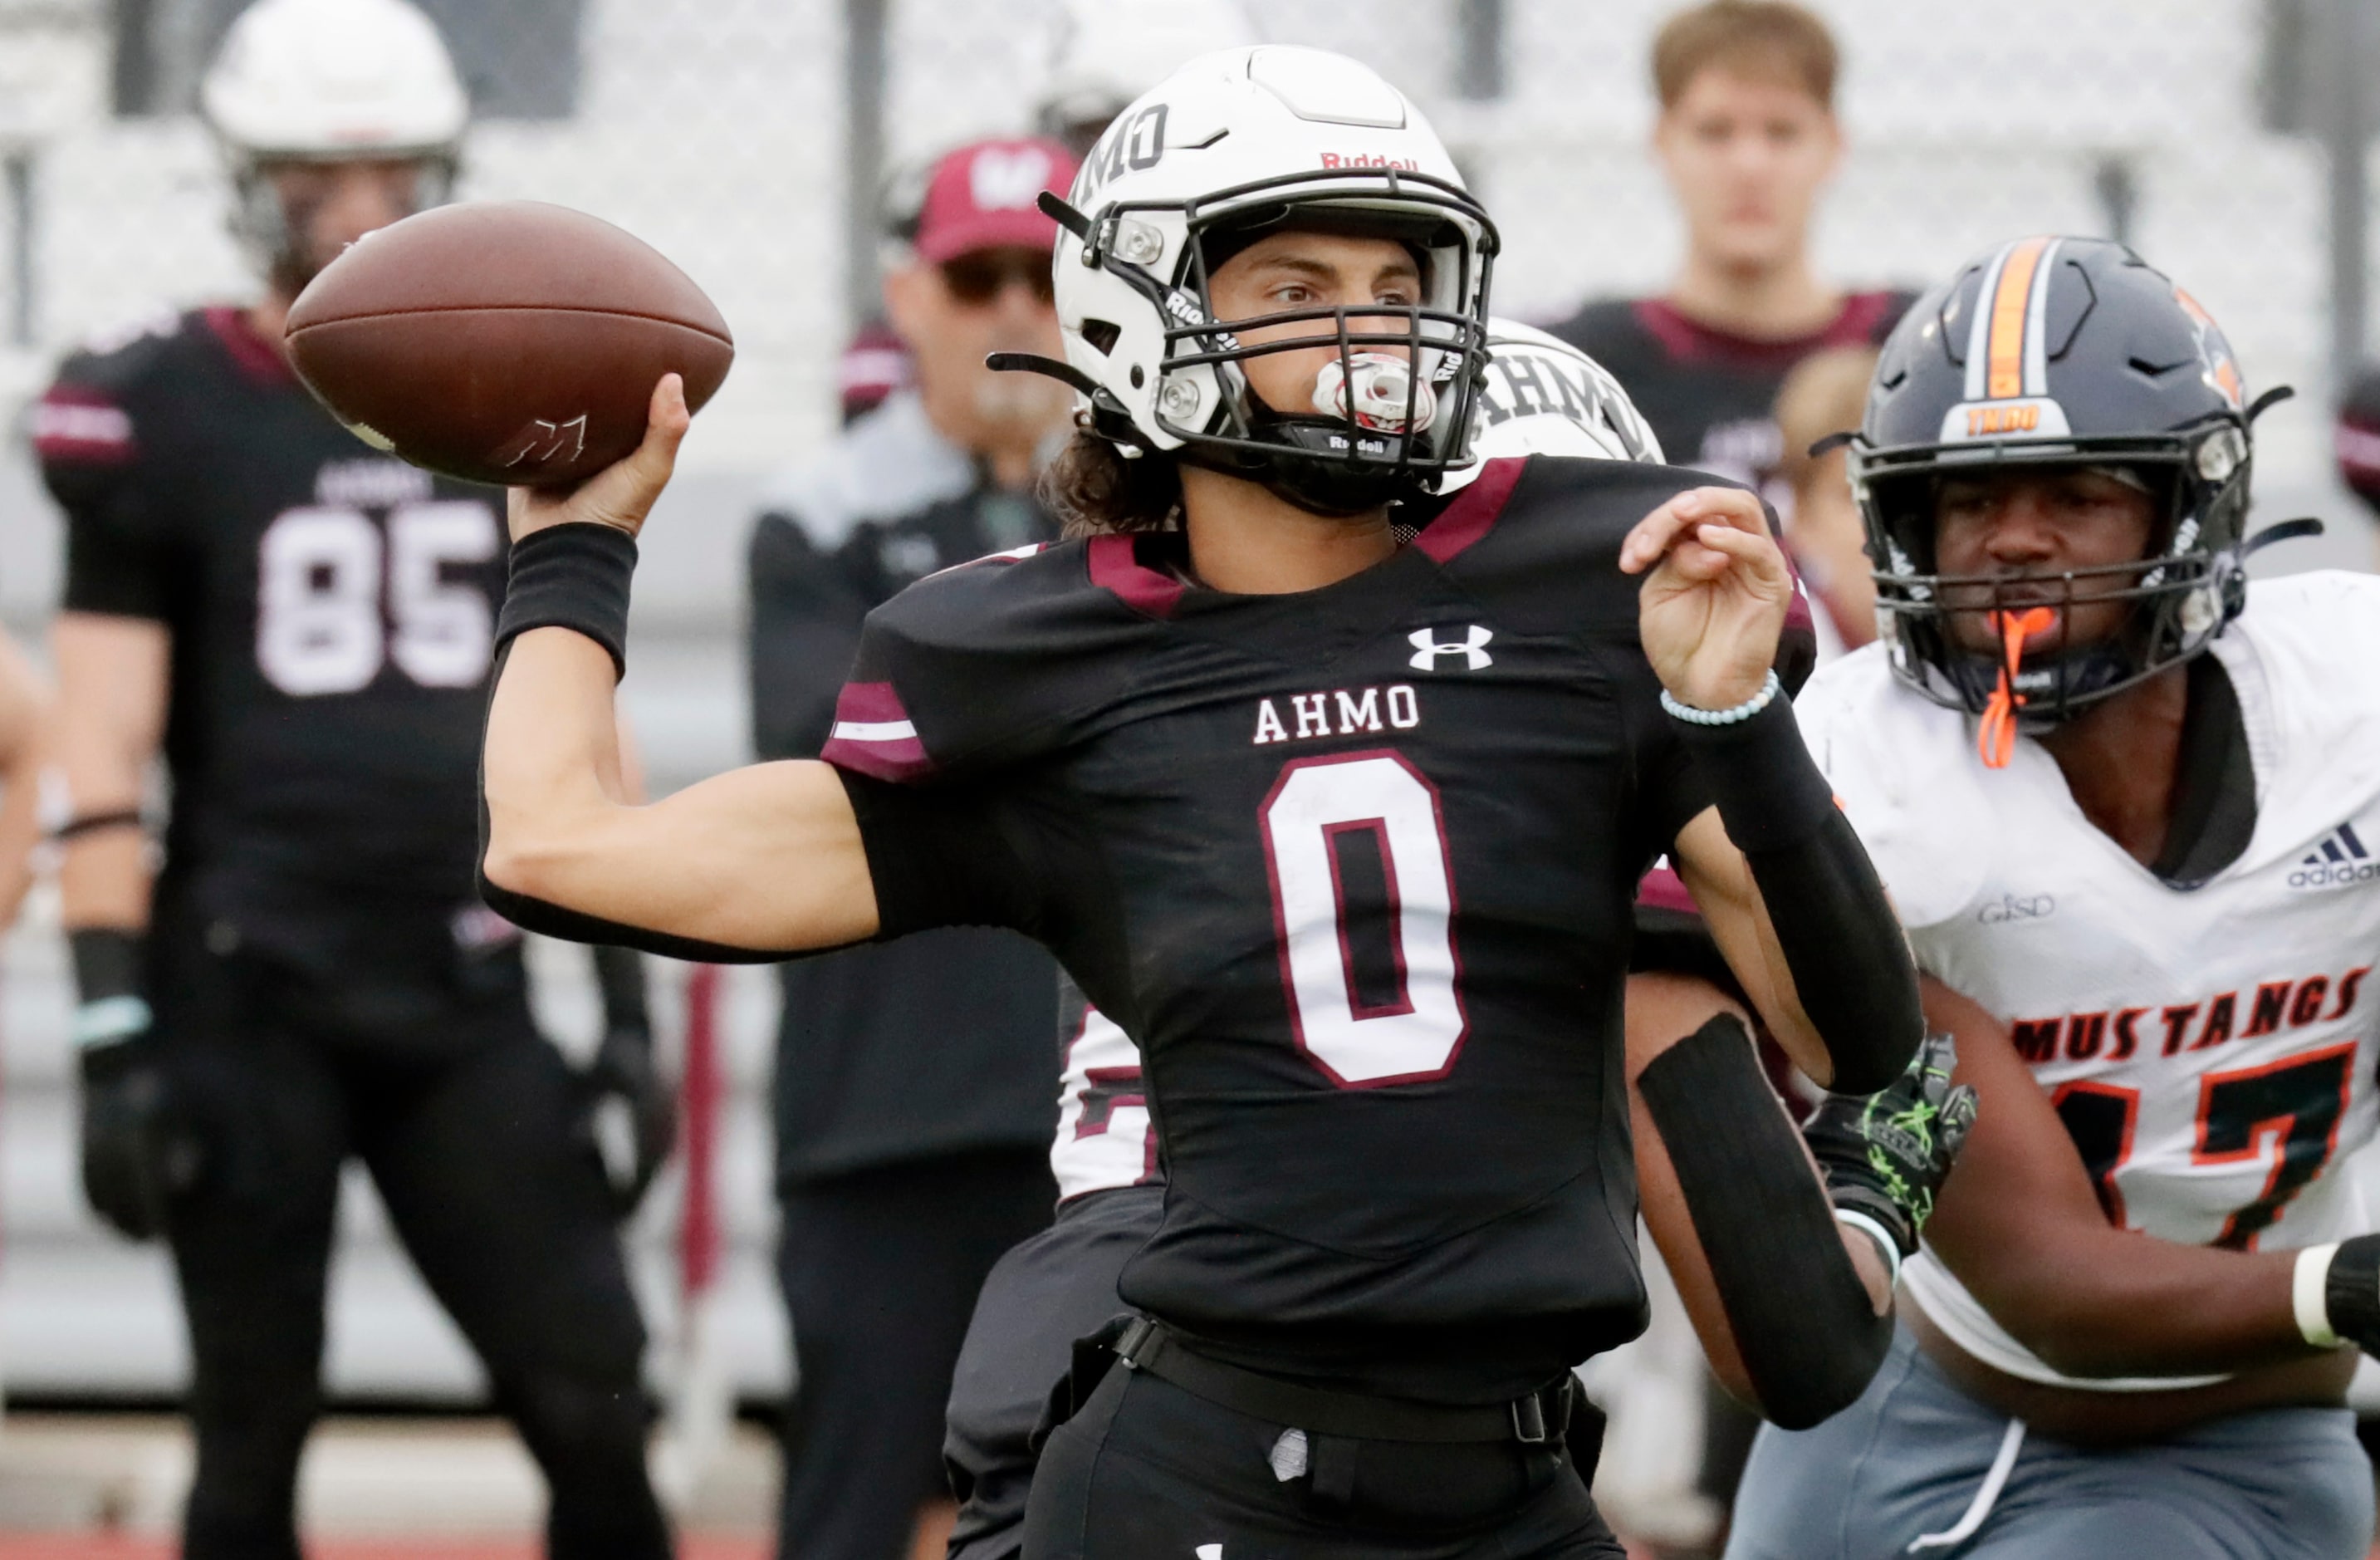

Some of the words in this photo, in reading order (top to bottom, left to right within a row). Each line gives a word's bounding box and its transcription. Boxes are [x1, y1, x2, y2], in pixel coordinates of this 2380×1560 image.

[257, 503, 500, 696] 85
[1253, 684, 1420, 744] AHMO
[1256, 749, 1471, 1090] 0
[2012, 967, 2373, 1063] MUSTANGS
